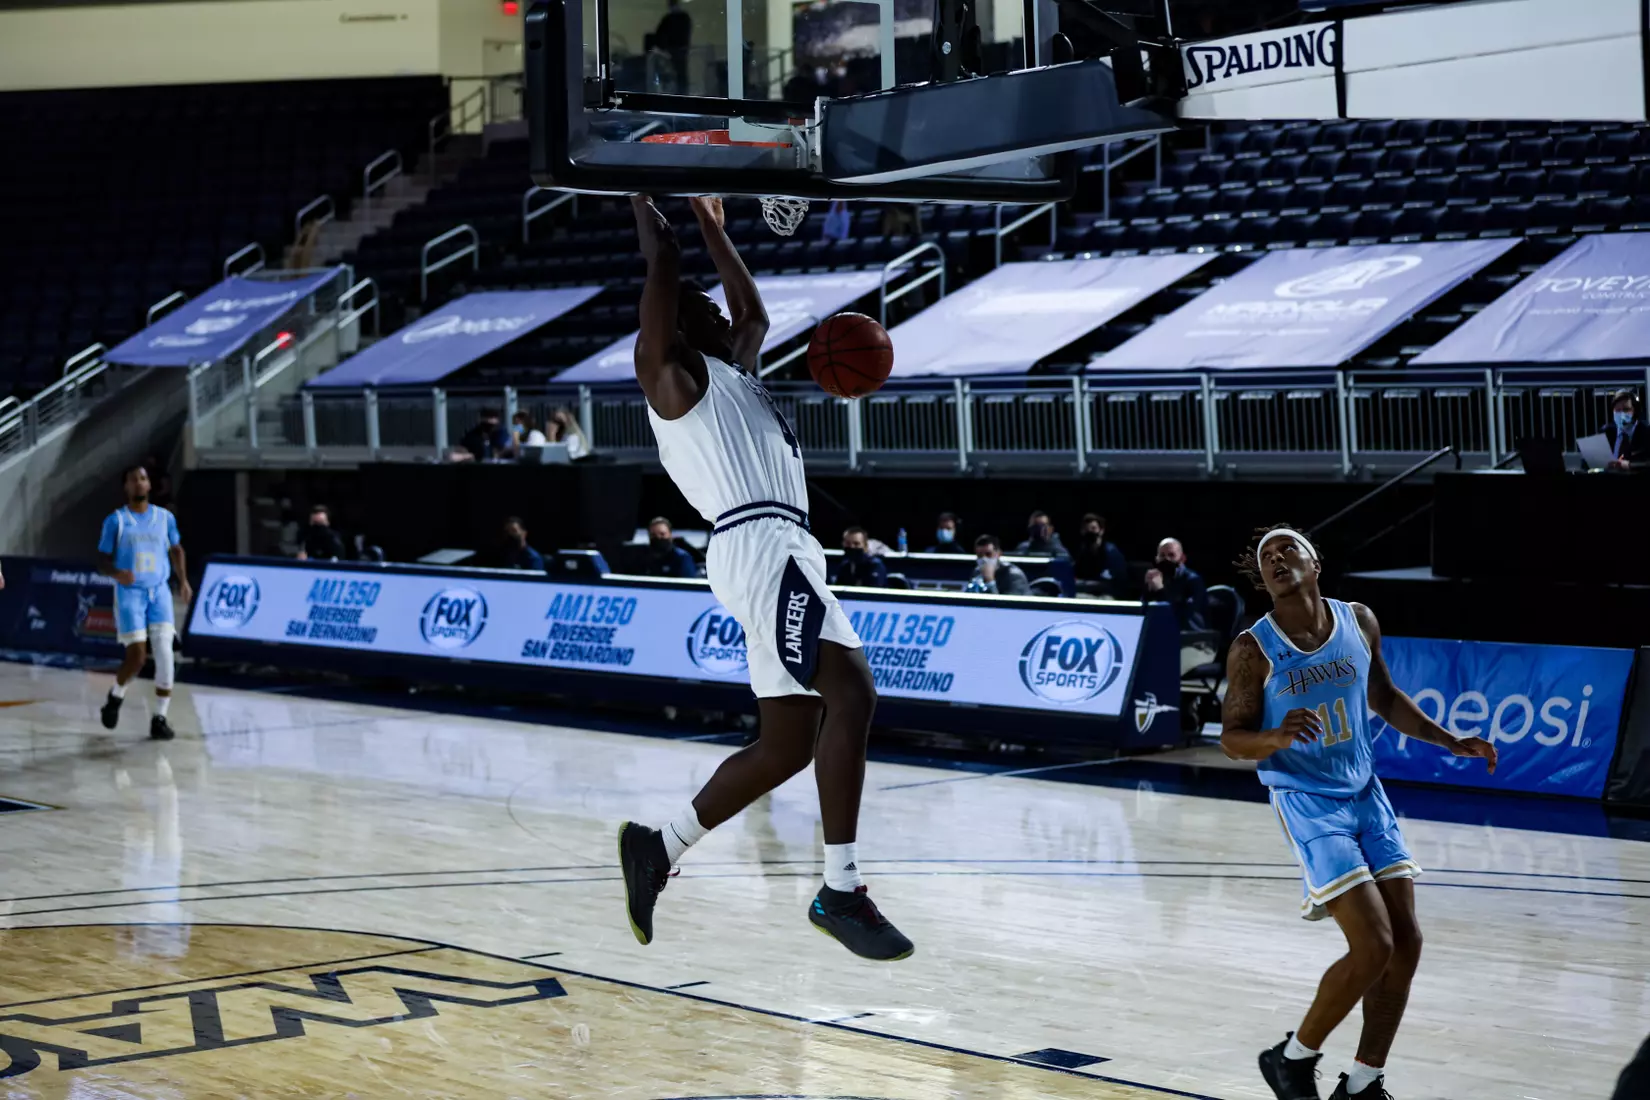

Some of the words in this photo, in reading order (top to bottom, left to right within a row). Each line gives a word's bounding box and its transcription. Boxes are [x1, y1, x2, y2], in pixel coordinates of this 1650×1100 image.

[1186, 23, 1336, 89] SPALDING
[216, 582, 252, 609] FOX
[306, 578, 382, 607] AM1350
[308, 604, 364, 624] RIVERSIDE
[434, 597, 476, 627] FOX
[544, 591, 638, 626] AM1350
[285, 619, 308, 637] SAN
[308, 621, 378, 644] BERNARDINO
[429, 626, 470, 640] SPORTS
[548, 621, 617, 645] RIVERSIDE
[785, 590, 810, 664] LANCERS
[521, 638, 550, 658] SAN
[549, 641, 635, 666] BERNARDINO
[865, 645, 931, 669] VERSIDE
[1039, 634, 1105, 673] FOX
[873, 667, 954, 693] RNARDINO
[1034, 671, 1098, 689] SPORTS
[1276, 656, 1356, 697] HAWKS
[1316, 697, 1352, 747] 11
[1397, 685, 1593, 750] pepsi
